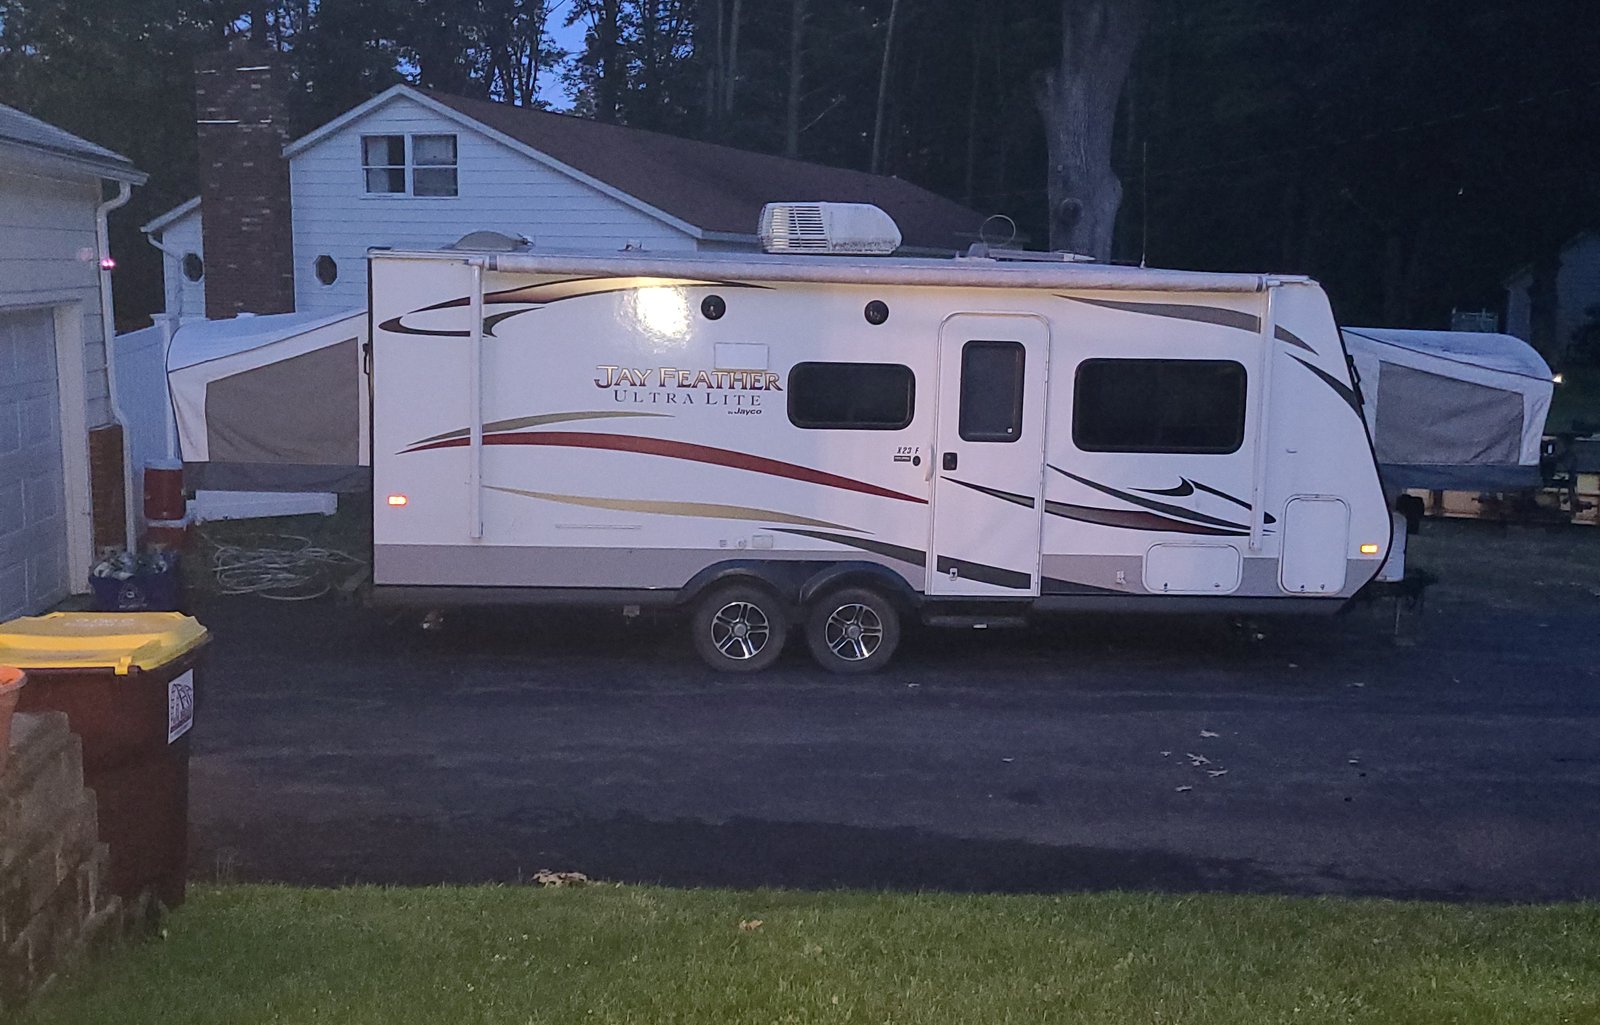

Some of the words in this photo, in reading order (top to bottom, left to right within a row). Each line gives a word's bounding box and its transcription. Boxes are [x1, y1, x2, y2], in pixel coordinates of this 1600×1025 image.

[594, 365, 652, 389] JAY
[658, 367, 784, 391] FEATHER
[614, 389, 694, 404] ULTRA
[705, 392, 761, 406] LITE
[733, 407, 762, 416] Jayco
